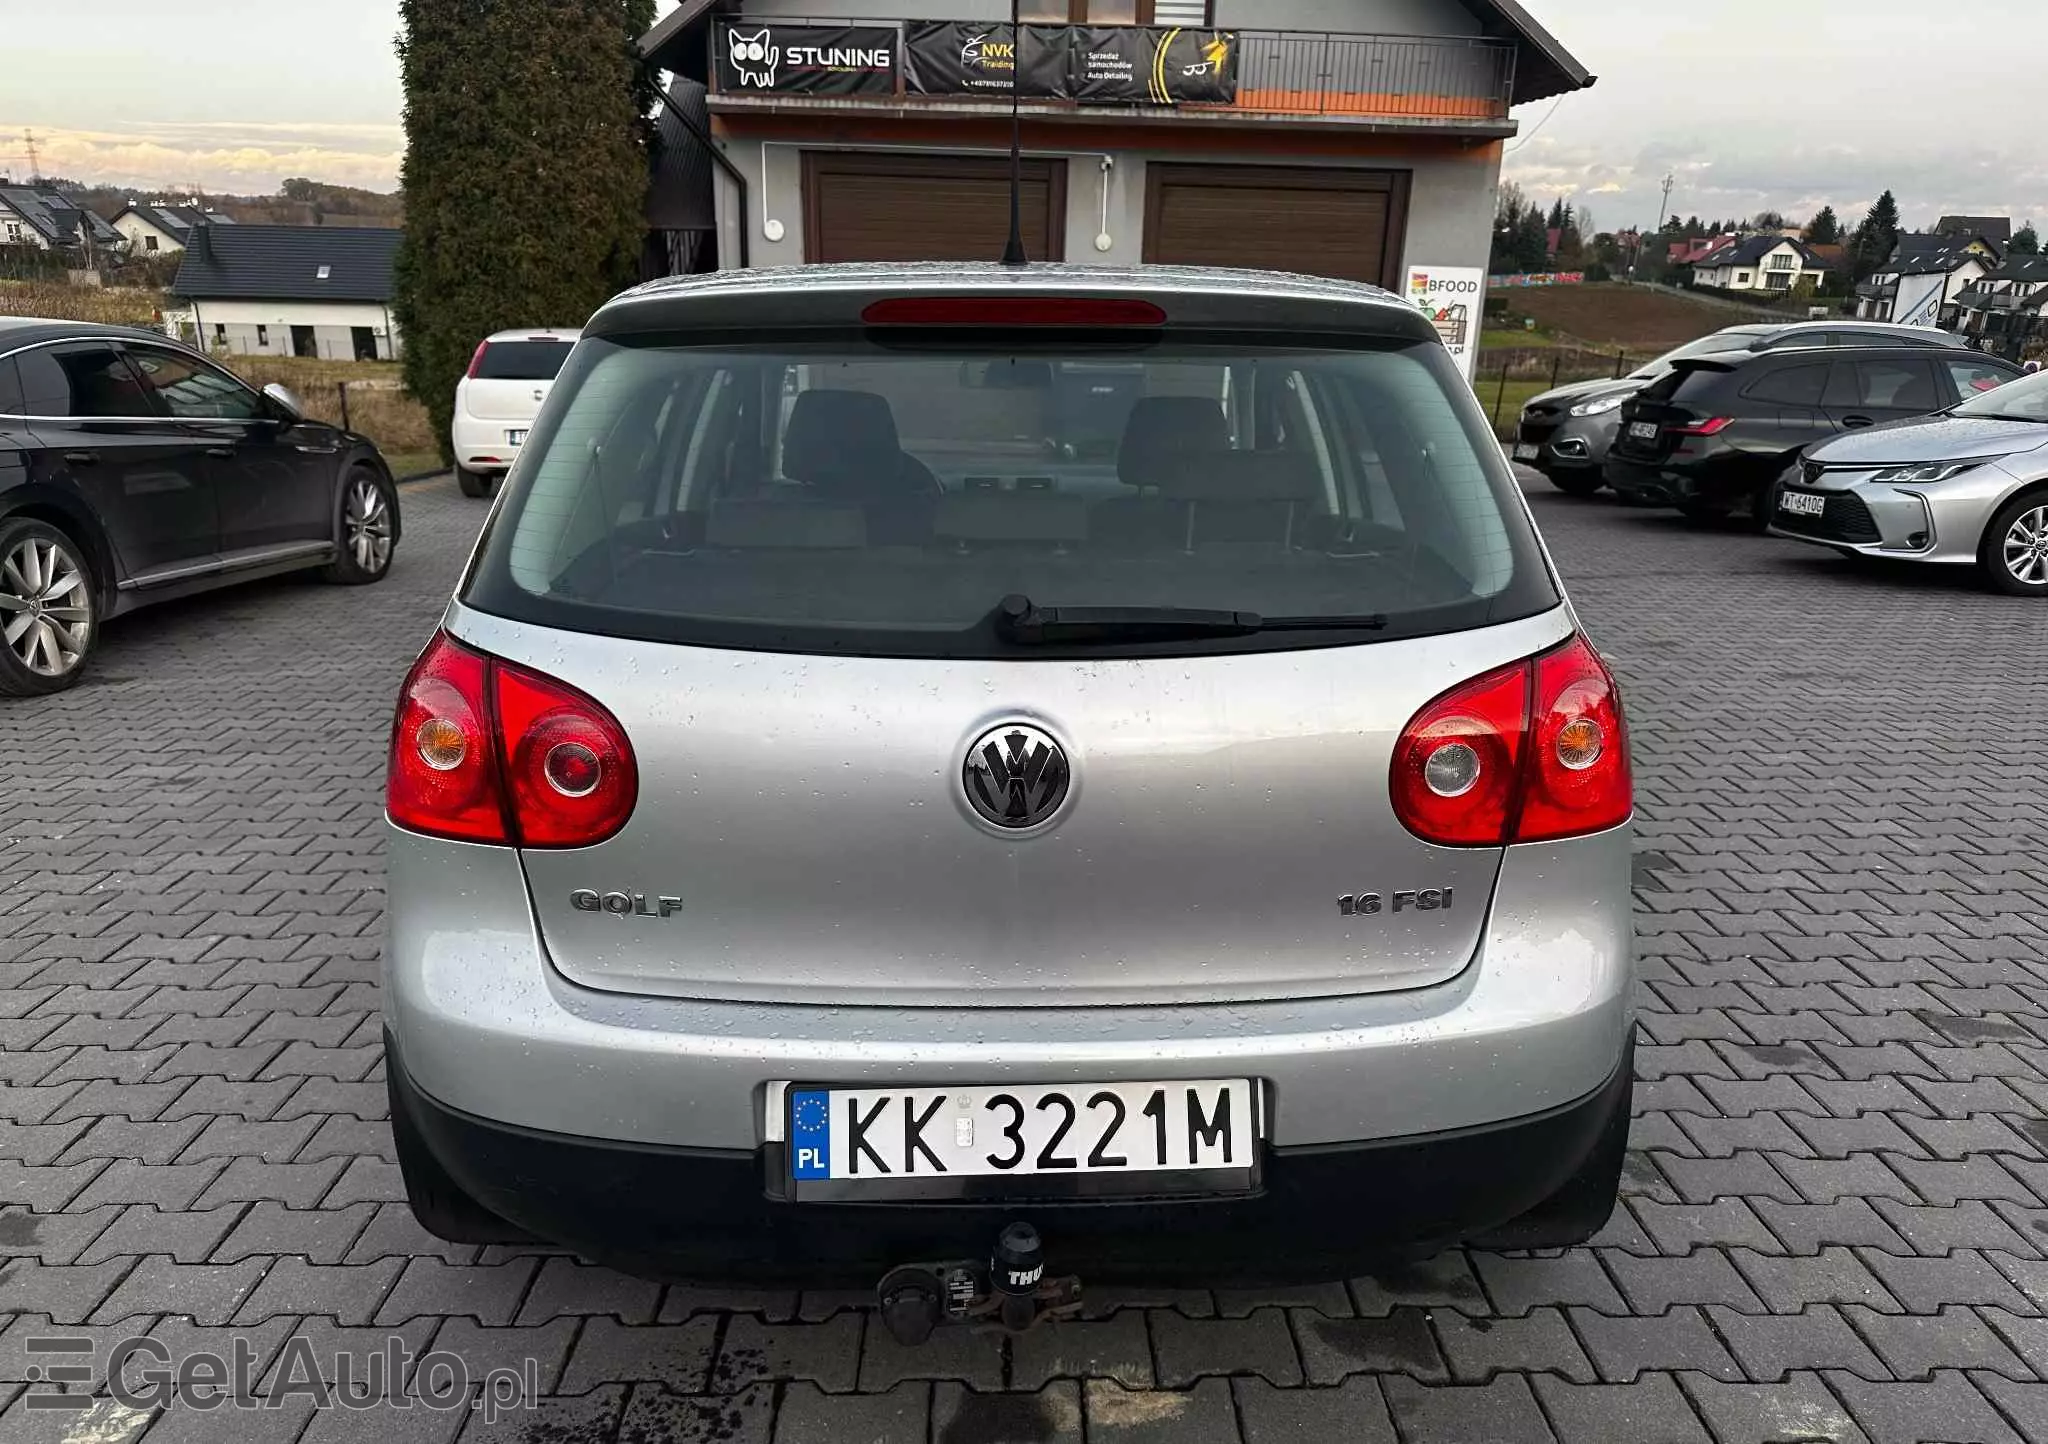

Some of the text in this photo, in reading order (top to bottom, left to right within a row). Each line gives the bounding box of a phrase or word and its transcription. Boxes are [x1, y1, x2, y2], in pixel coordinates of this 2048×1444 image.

[786, 47, 890, 67] STUNING
[982, 44, 1014, 57] NVK
[1104, 72, 1132, 81] Detailing
[1429, 280, 1477, 292] BFOOD
[570, 889, 682, 918] GOLF
[1392, 887, 1453, 914] FSI
[848, 1088, 1233, 1174] KK 3221M
[798, 1148, 825, 1168] PL
